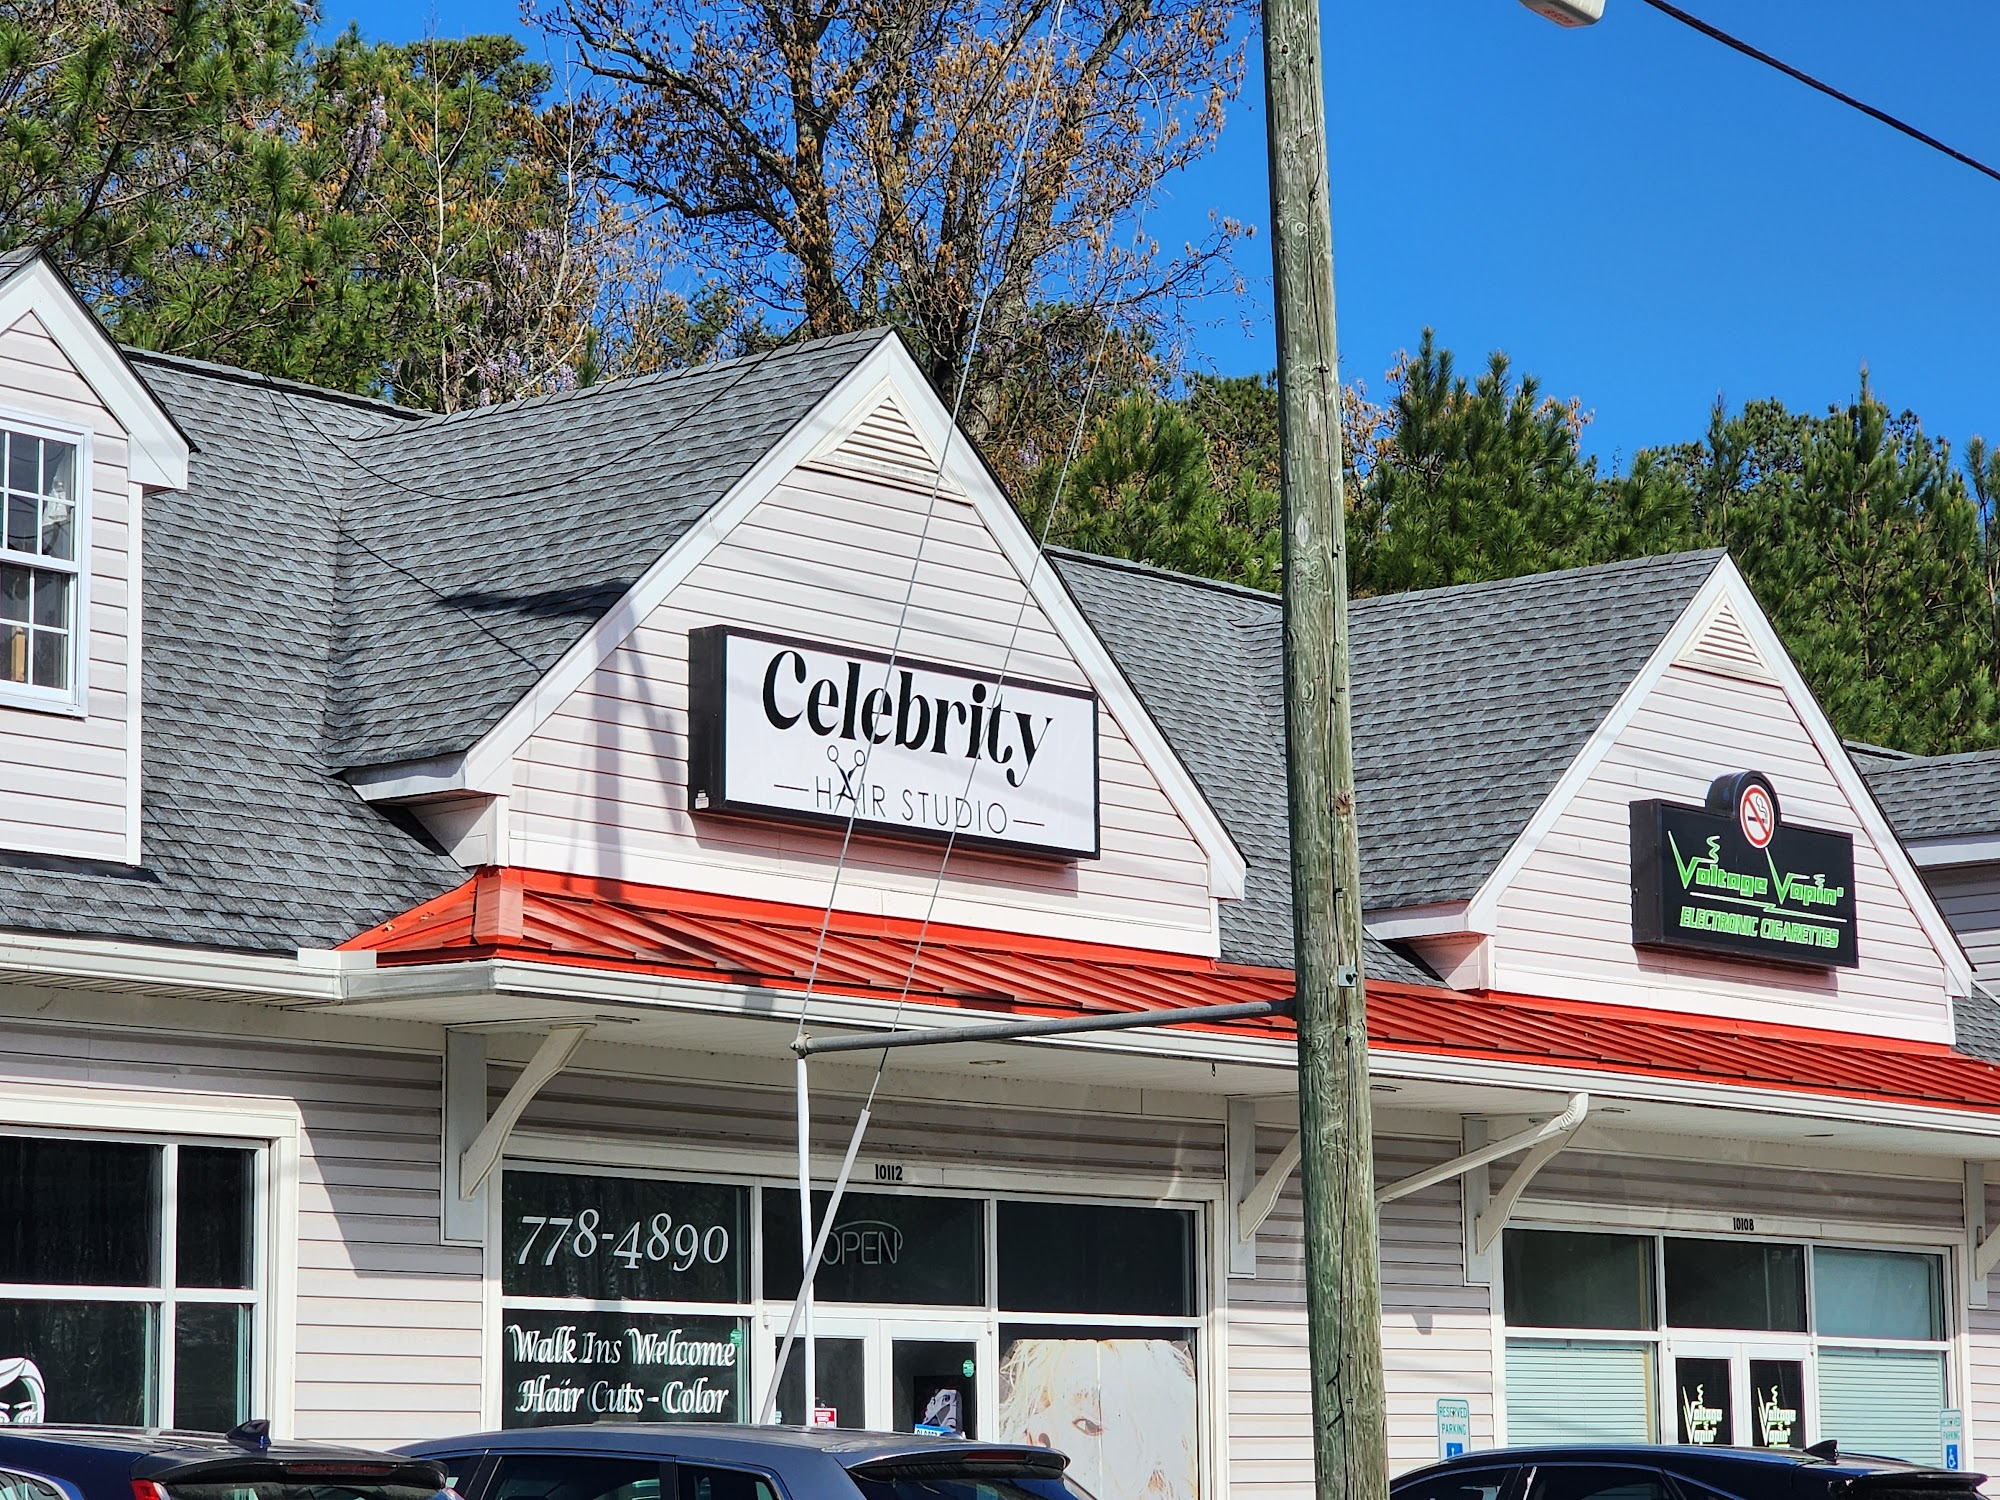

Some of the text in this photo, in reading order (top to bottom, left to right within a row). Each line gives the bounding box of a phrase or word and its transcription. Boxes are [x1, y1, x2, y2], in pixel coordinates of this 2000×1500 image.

[763, 650, 1054, 788] Celebrity
[815, 776, 1008, 835] HAIR STUDIO
[1668, 831, 1768, 898] Voltage
[1679, 906, 1840, 949] ELECTRONIC CIGARETTES
[875, 1163, 903, 1181] 10112
[518, 1208, 729, 1272] 778-4890
[822, 1231, 898, 1266] OPEN
[507, 1324, 578, 1364] Walk
[581, 1332, 622, 1364] Ins
[626, 1328, 736, 1367] Welcome
[517, 1374, 584, 1414] Hair
[1439, 1406, 1467, 1418] RESERVED
[1441, 1423, 1467, 1435] PARKING
